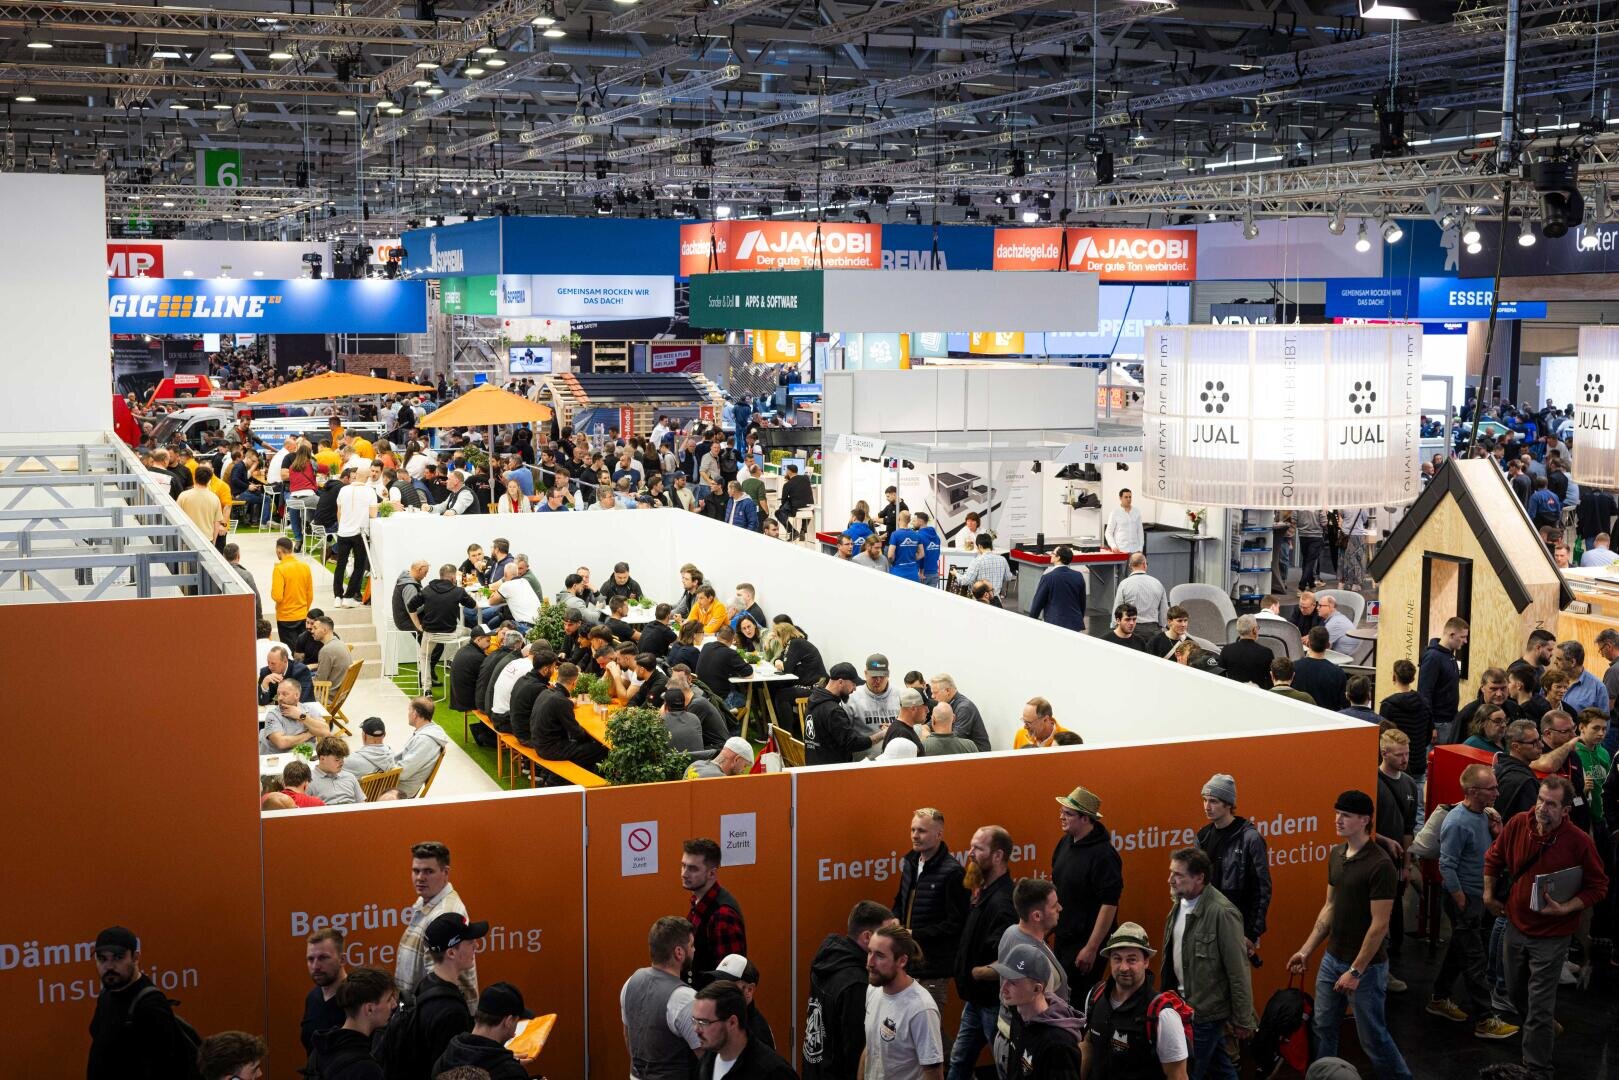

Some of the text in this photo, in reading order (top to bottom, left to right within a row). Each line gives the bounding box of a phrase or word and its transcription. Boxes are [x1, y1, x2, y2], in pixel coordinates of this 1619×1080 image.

[217, 163, 238, 187] 6
[682, 238, 727, 258] dachzieg.de
[769, 232, 872, 254] JACOBI
[997, 243, 1059, 261] dachziegel.de
[1099, 239, 1189, 260] JACOBI
[756, 255, 775, 266] Der
[777, 256, 801, 268] gute
[823, 257, 873, 267] verbindet.
[1087, 261, 1189, 272] Der gute Ton verbindet.
[557, 288, 602, 296] GEMEINSAM
[603, 288, 633, 296] ROCKEN
[583, 297, 624, 305] DAS DACH!
[745, 296, 760, 308] APPS
[767, 296, 798, 308] SOFTWARE
[1341, 289, 1370, 297] GEMEINSAM
[192, 296, 265, 318] LINE
[1579, 411, 1610, 430] JUAL
[1192, 424, 1240, 444] JUAL
[1340, 424, 1384, 445] JUAL
[1406, 599, 1415, 661] RAMELINE
[726, 839, 750, 849] Zutritt
[729, 830, 748, 839] Kein
[1111, 826, 1195, 851] bstürze
[1268, 840, 1338, 867] tectio
[346, 924, 543, 967] Gre ofing
[37, 965, 198, 1004] Insuion
